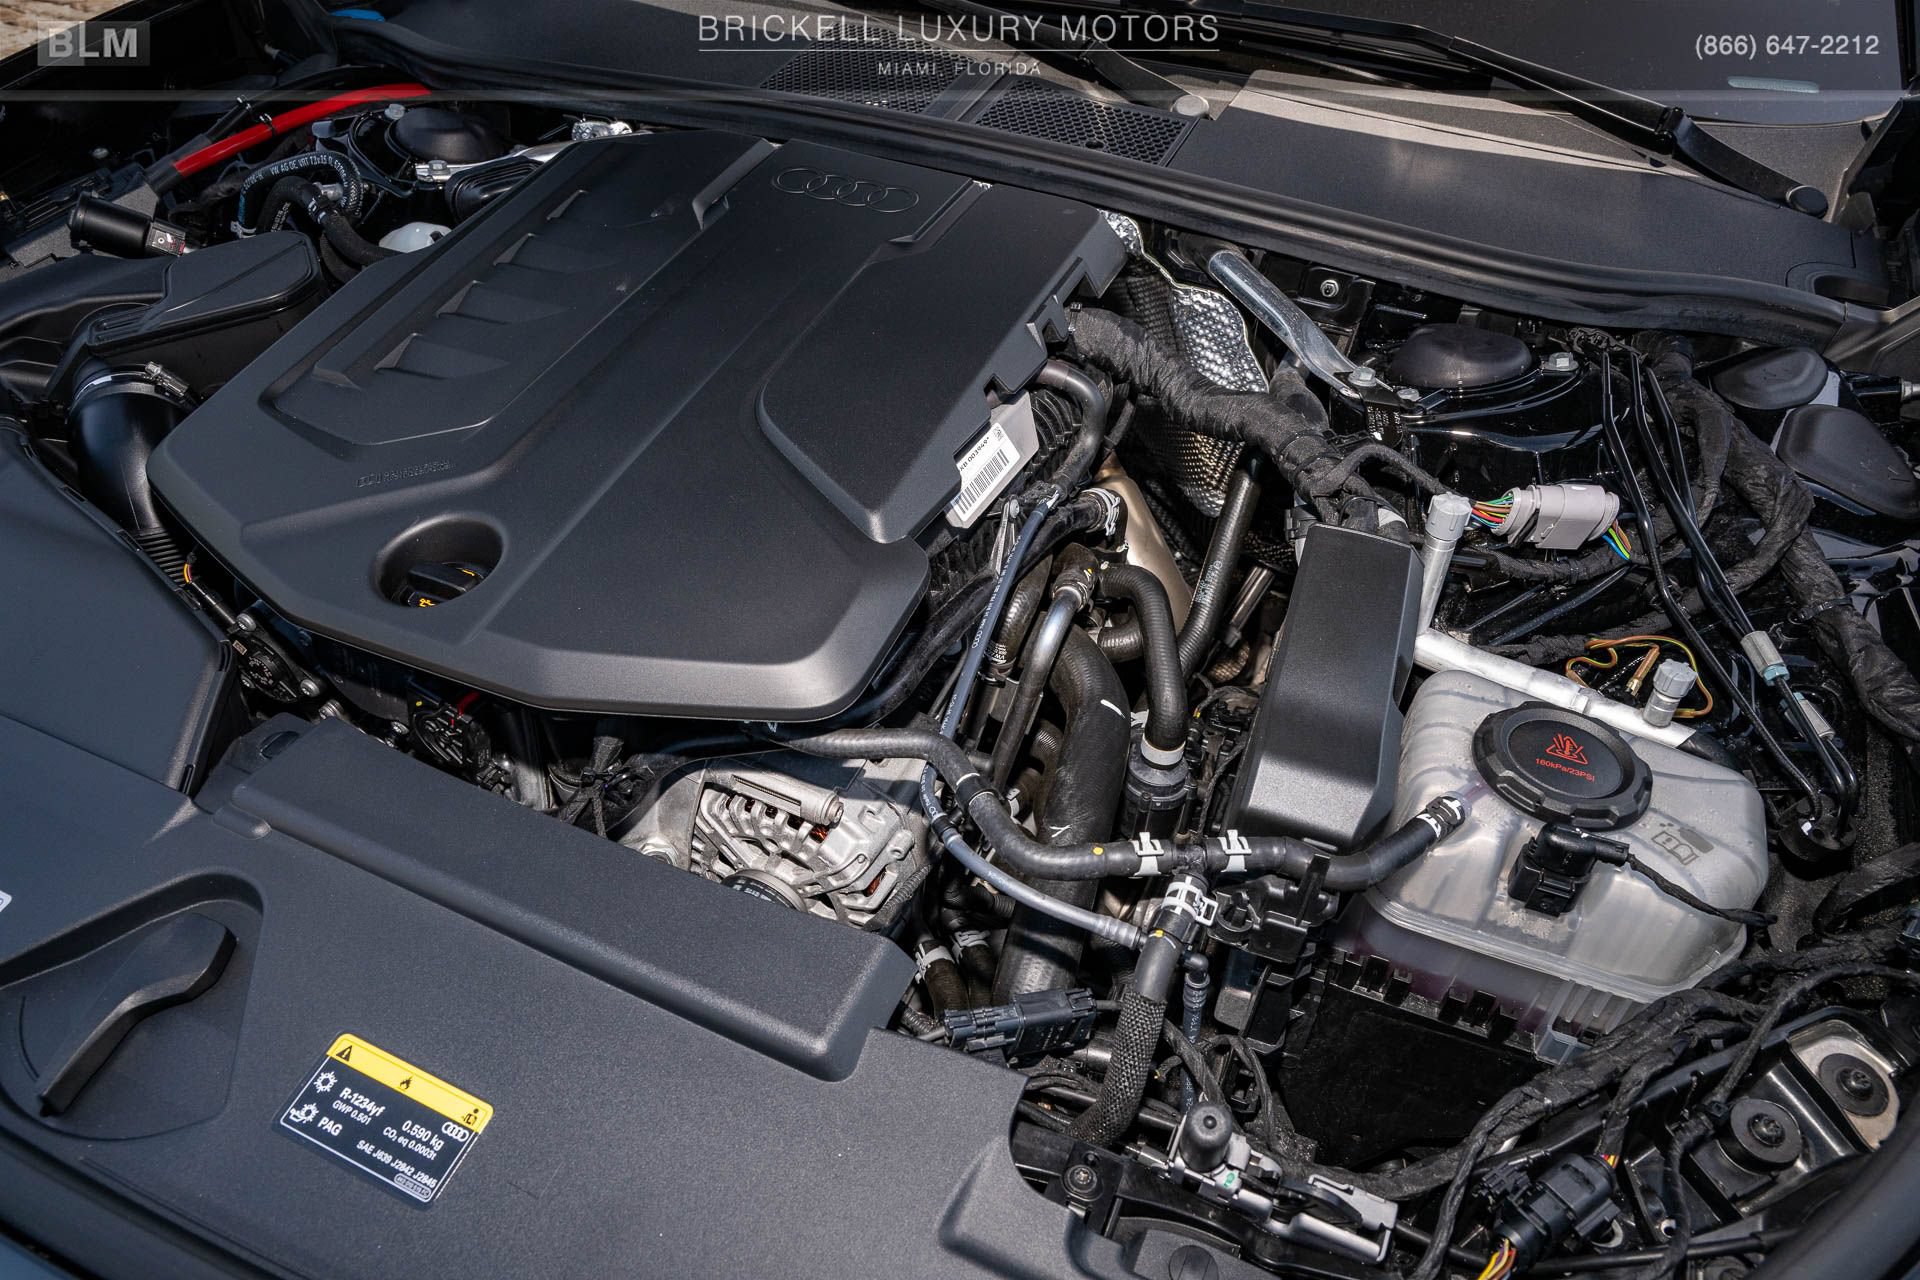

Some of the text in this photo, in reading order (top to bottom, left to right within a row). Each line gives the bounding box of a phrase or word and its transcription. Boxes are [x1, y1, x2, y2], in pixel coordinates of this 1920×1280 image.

[280, 161, 290, 173] AG
[339, 1086, 386, 1117] R-1234yf
[332, 1099, 372, 1125] GWP 0.501
[317, 1116, 343, 1136] PAG
[401, 1119, 445, 1152] 0.590 kg
[356, 1139, 376, 1155] SAE
[397, 1135, 410, 1148] eq
